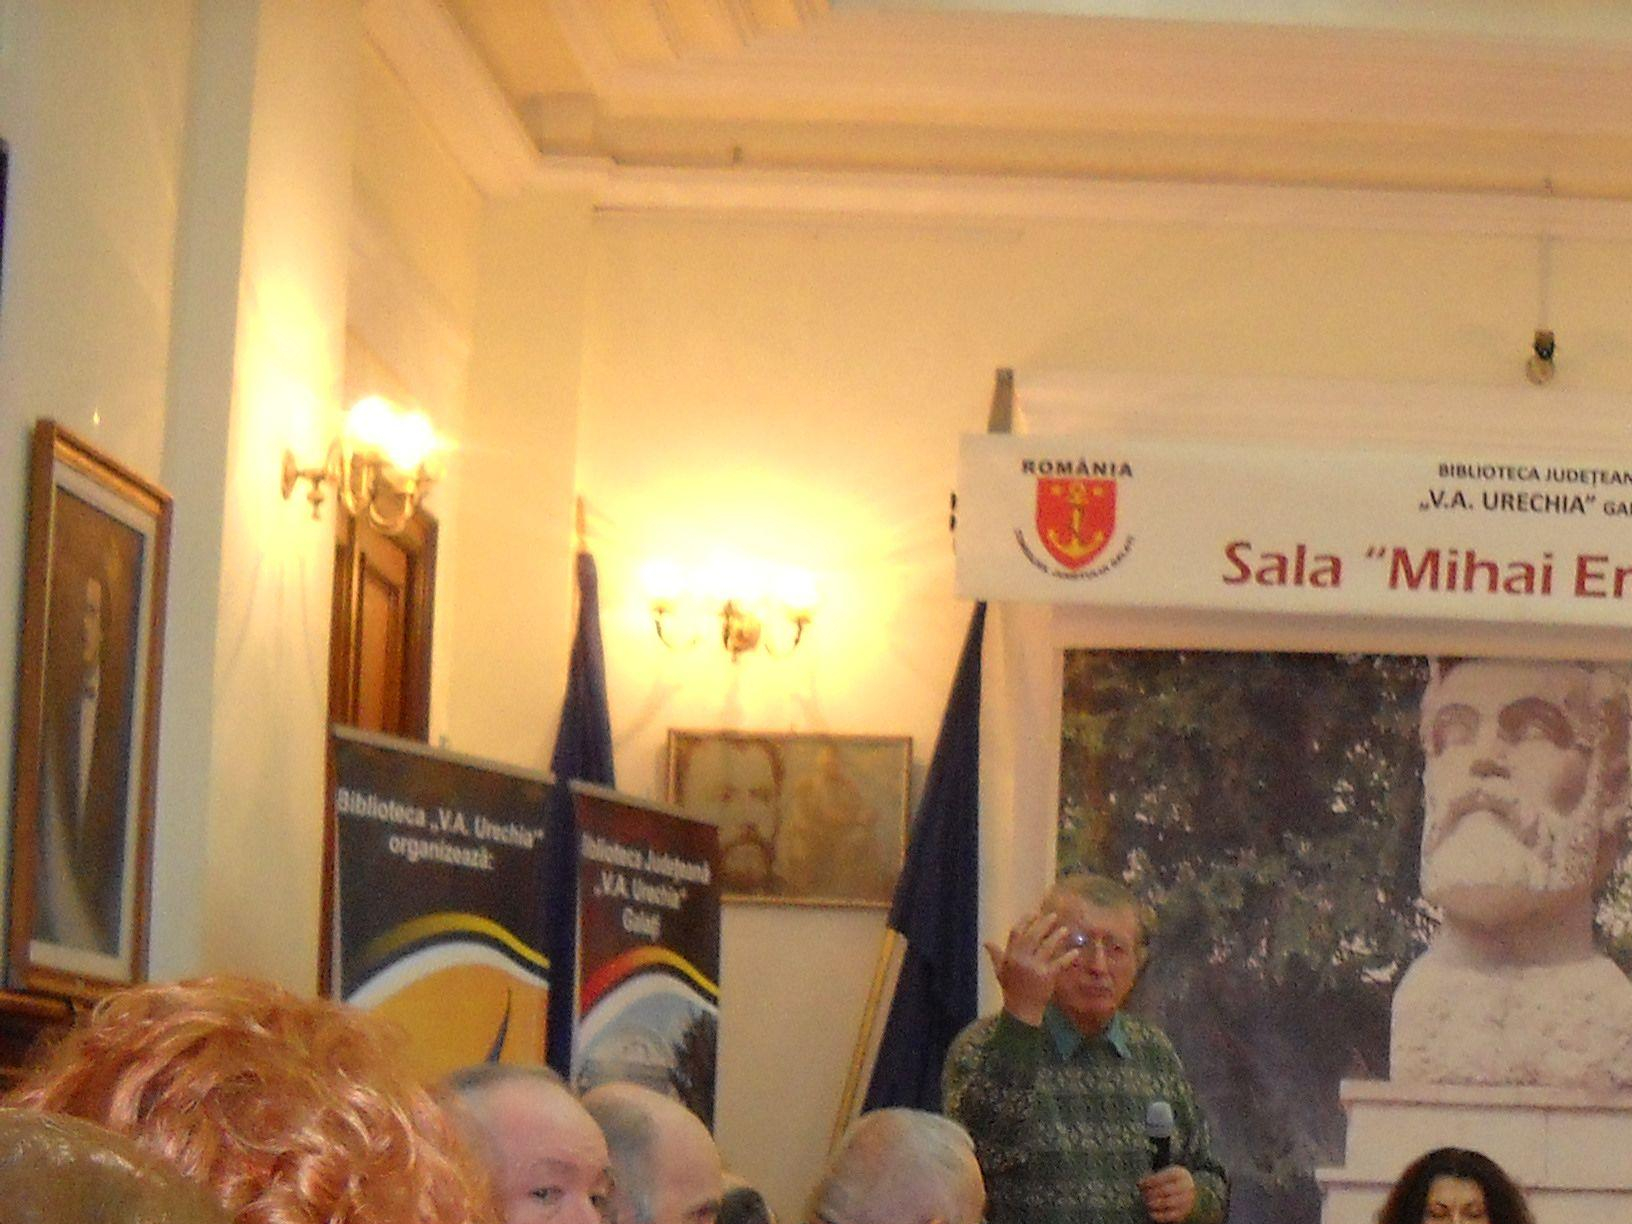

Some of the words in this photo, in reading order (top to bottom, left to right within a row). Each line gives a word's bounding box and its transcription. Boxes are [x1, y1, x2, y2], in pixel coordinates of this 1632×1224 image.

[1438, 463, 1540, 481] BIBLIOTECA
[1222, 541, 1343, 588] Sala
[337, 787, 426, 828] Biblioteca
